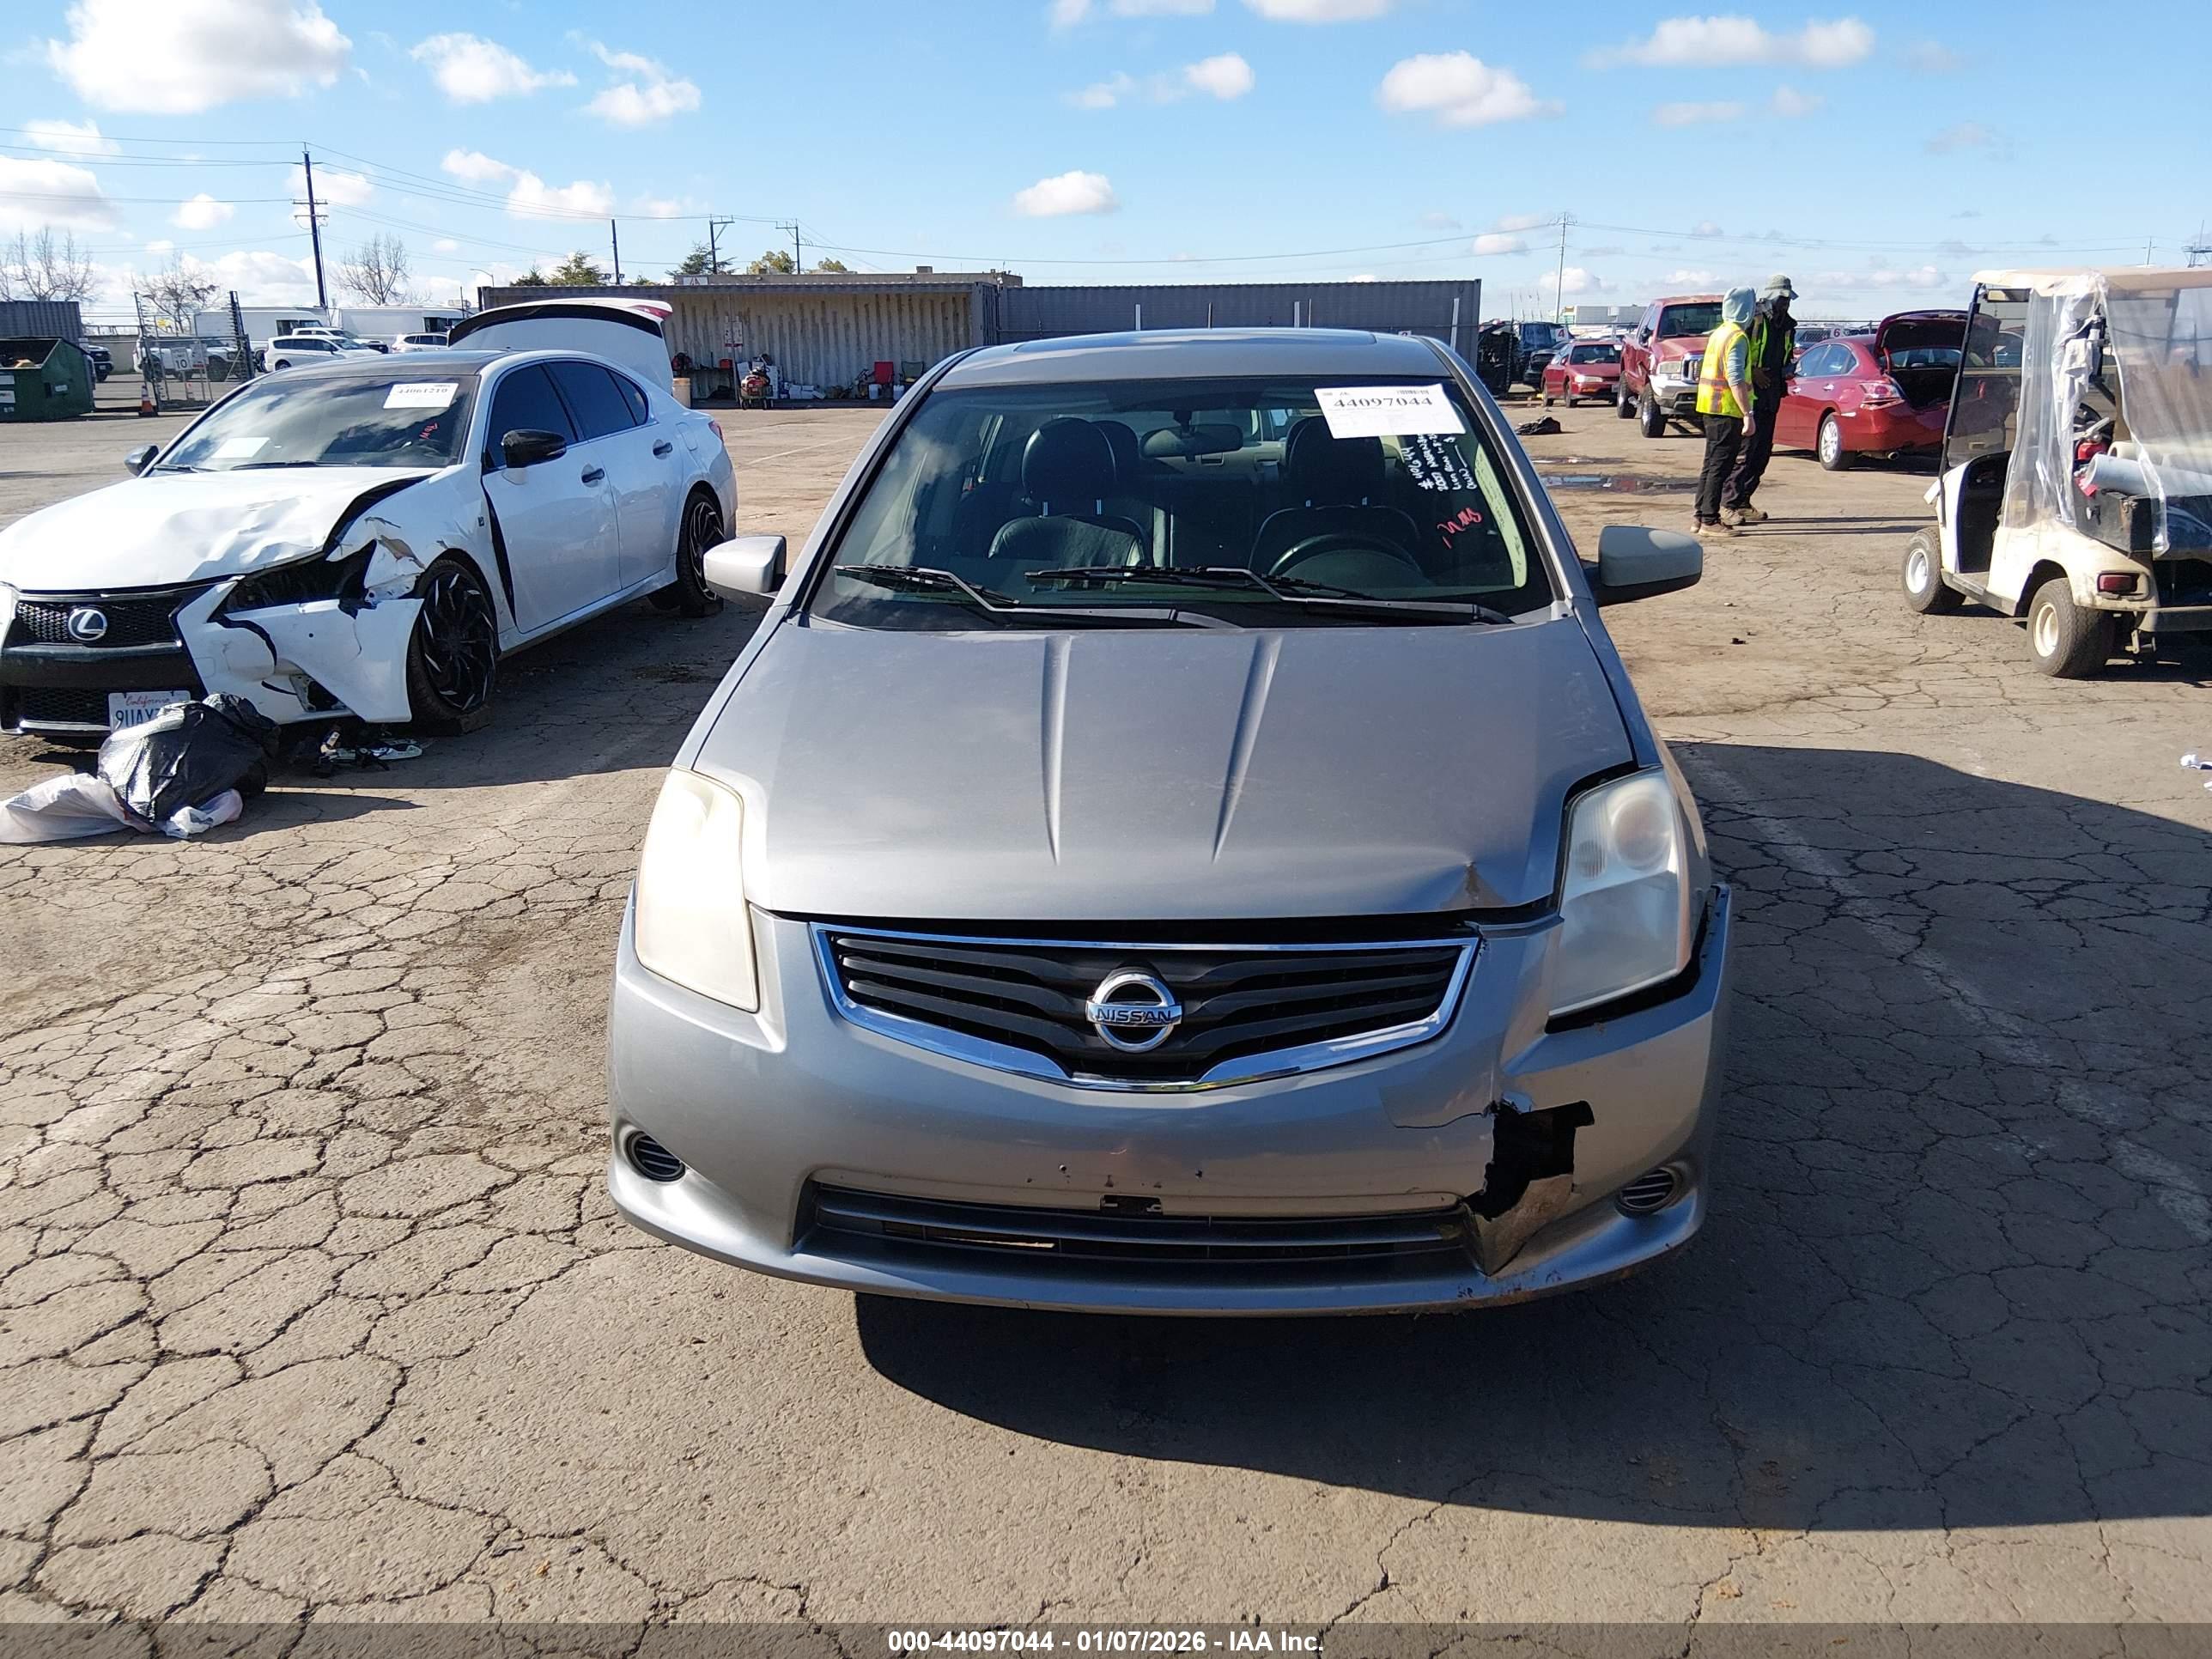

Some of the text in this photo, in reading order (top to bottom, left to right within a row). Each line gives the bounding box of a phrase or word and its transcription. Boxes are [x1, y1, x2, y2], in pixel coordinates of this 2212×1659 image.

[1833, 328, 1841, 337] 6
[175, 359, 187, 368] 10
[1334, 397, 1433, 408] 44097044
[1097, 1008, 1171, 1024] NISSAN
